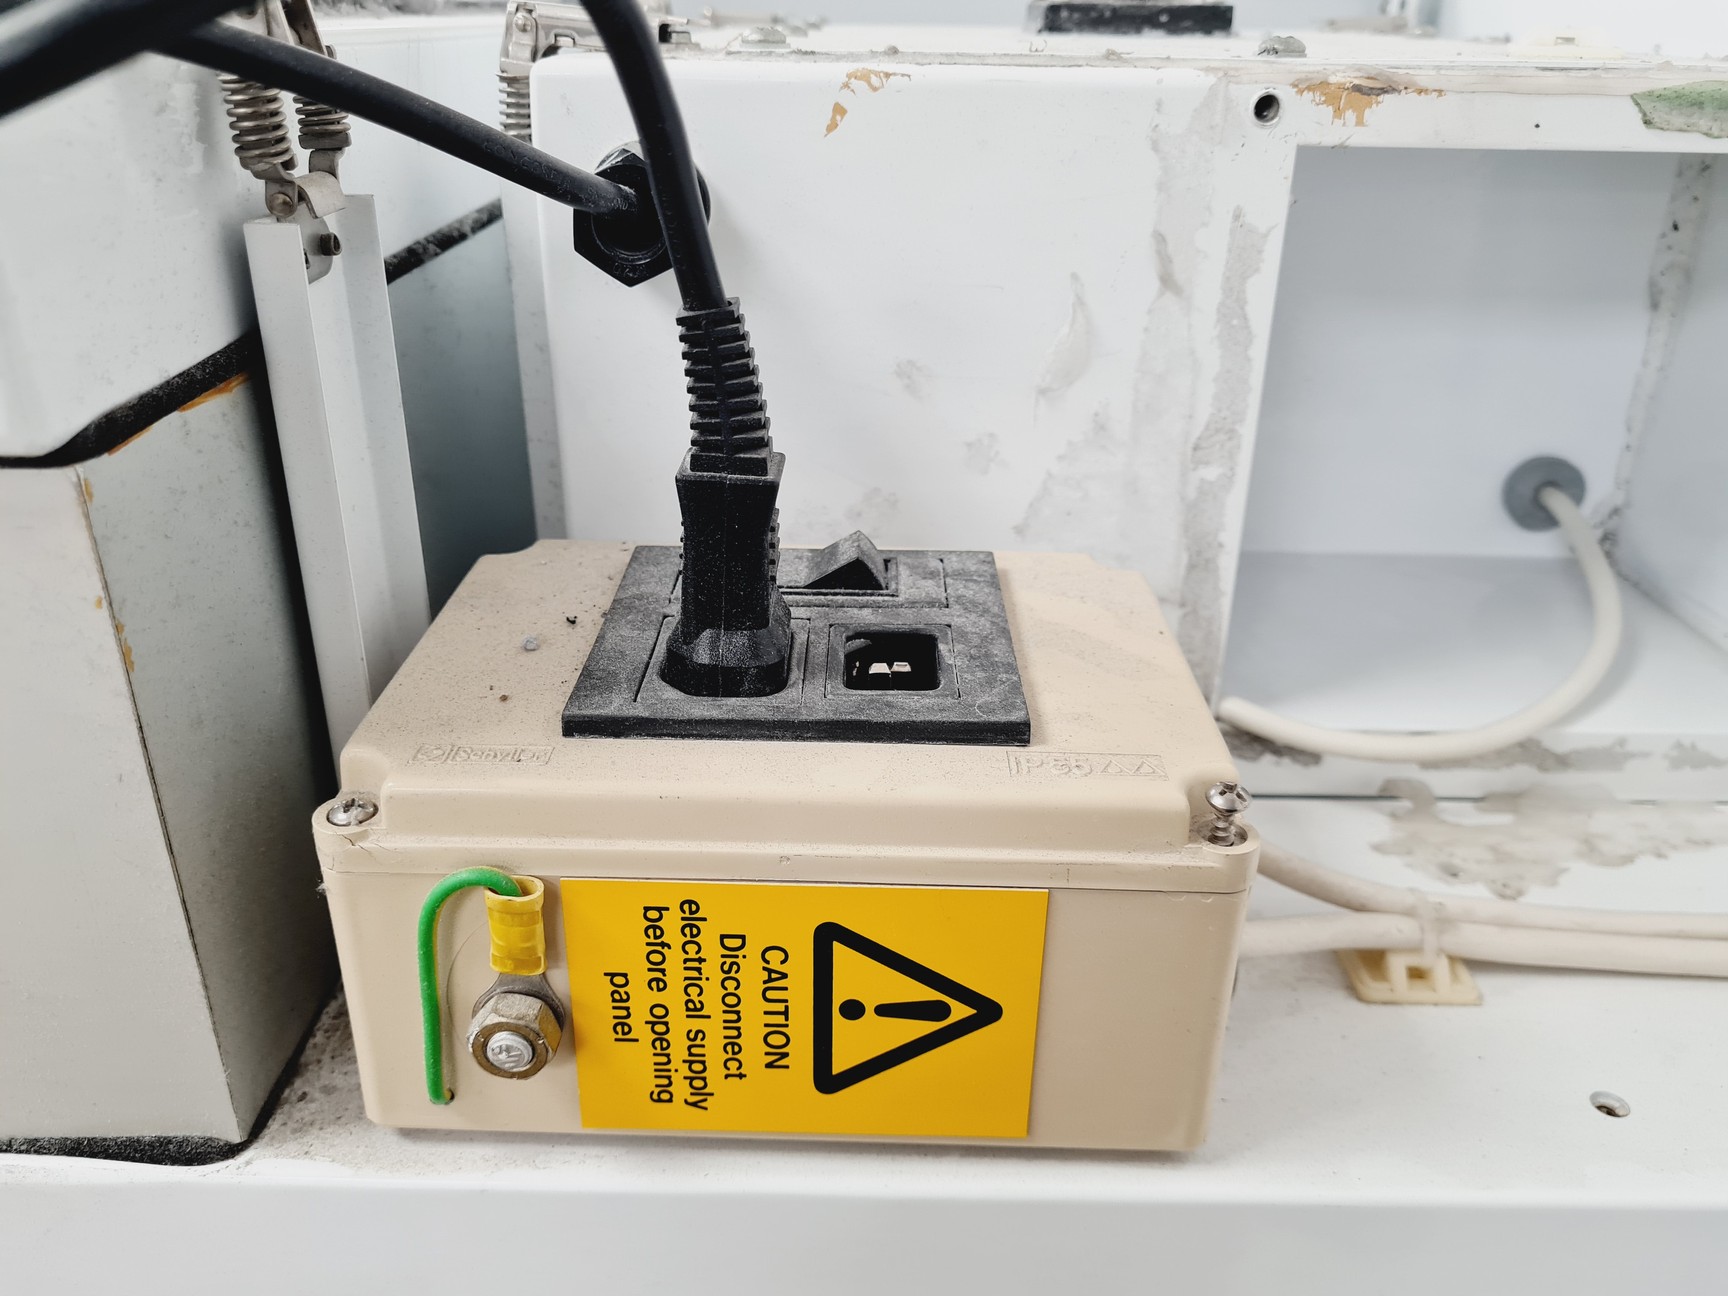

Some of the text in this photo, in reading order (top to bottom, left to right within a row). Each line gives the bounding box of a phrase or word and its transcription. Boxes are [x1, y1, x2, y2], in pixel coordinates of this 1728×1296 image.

[603, 972, 640, 1043] panel
[642, 905, 678, 1104] before opening
[679, 899, 715, 1111] electrical supply
[719, 933, 747, 1081] Disconnect
[760, 945, 791, 1070] CAUTION
